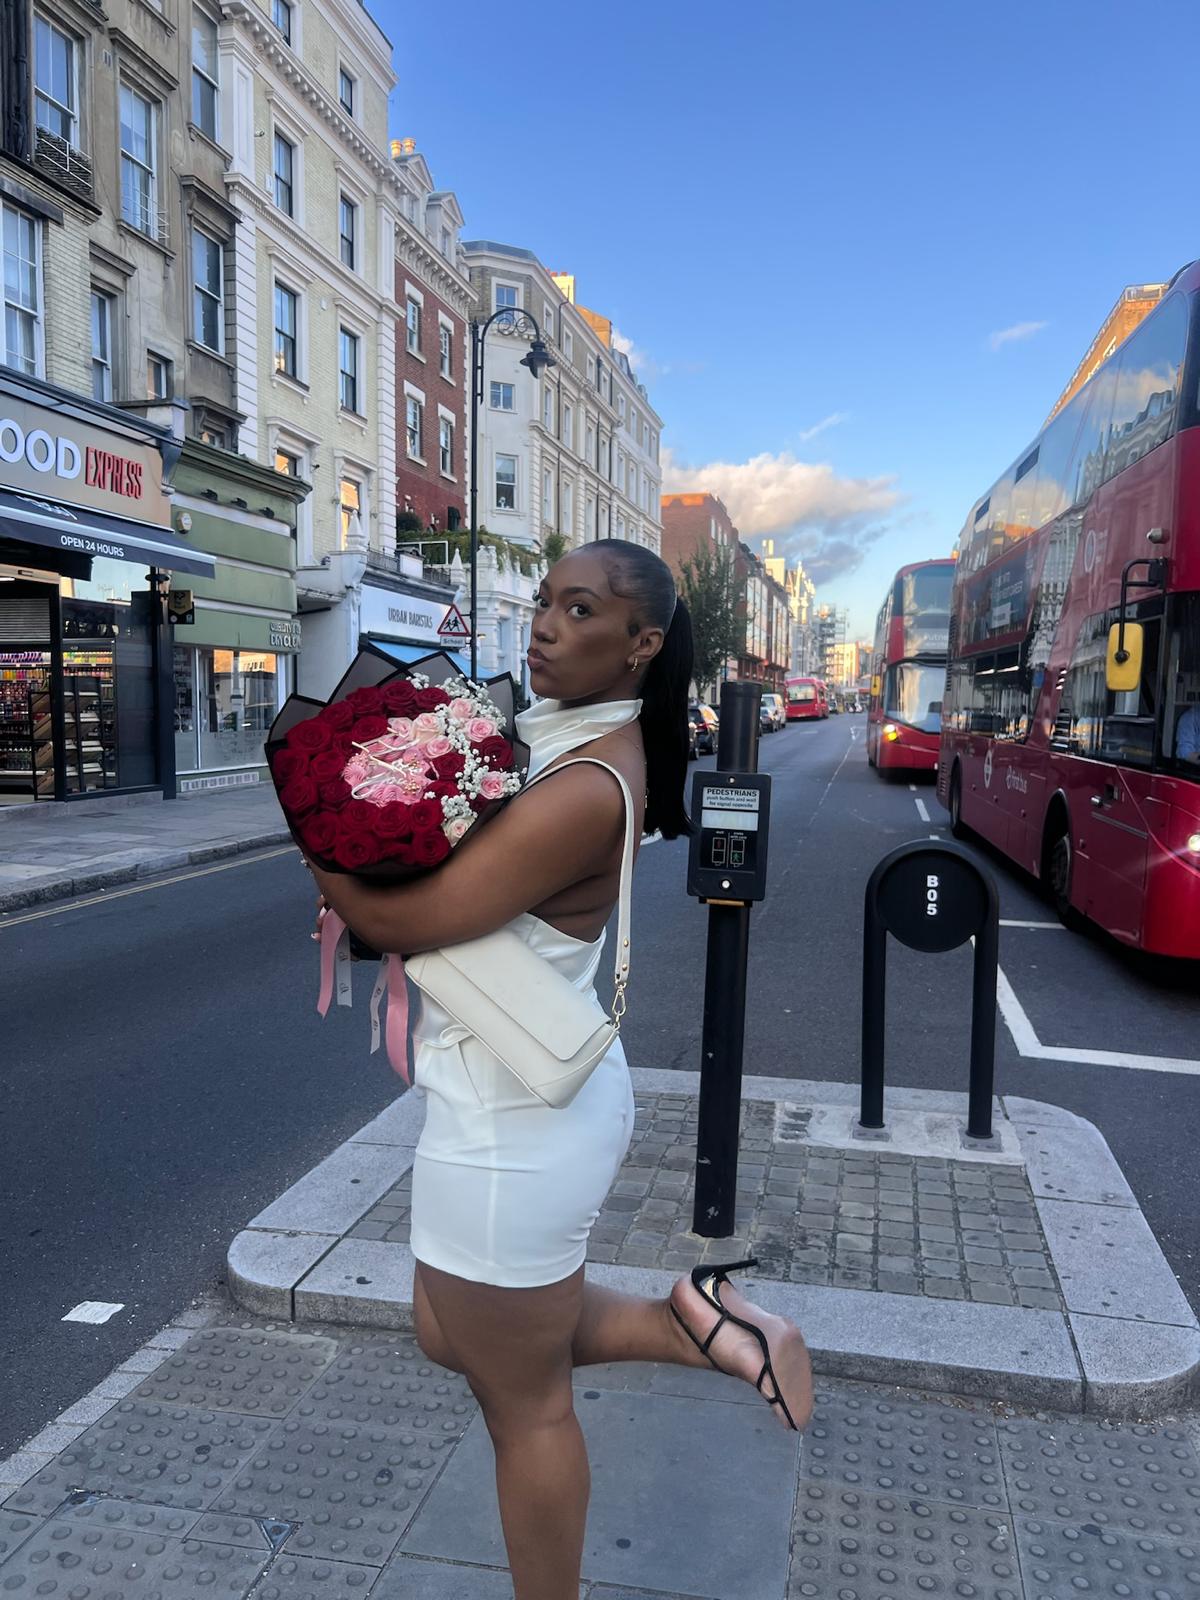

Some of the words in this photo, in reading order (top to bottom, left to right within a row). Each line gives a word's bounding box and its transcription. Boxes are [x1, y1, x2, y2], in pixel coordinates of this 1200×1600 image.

[85, 446, 144, 500] EXPRESS
[60, 535, 84, 549] OPEN
[85, 540, 96, 551] 24
[97, 543, 125, 557] HOURS
[388, 607, 408, 625] URBAN
[707, 789, 757, 797] PEDESTRIANS
